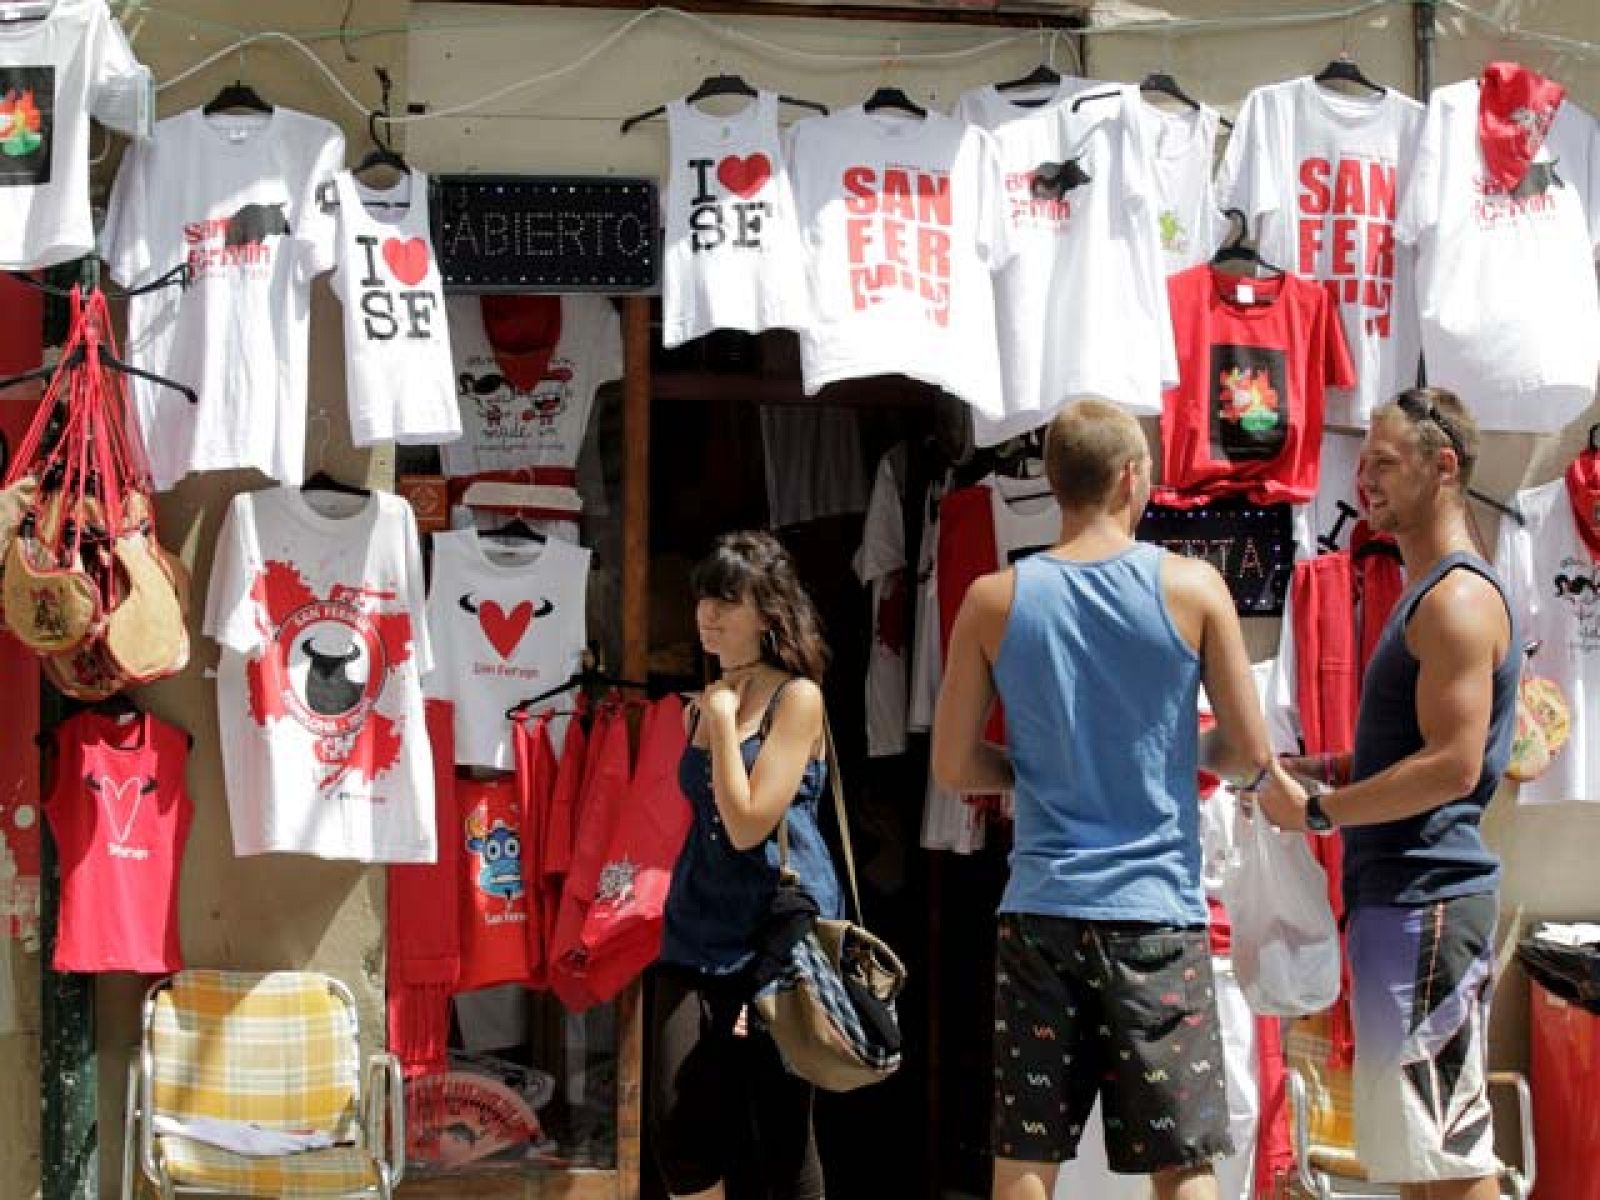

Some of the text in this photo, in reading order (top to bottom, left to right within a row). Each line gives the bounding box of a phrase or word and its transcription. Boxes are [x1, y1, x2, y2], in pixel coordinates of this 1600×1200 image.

[688, 159, 717, 206] I
[842, 166, 953, 226] SAN
[1297, 156, 1397, 222] SAN
[450, 212, 644, 257] ABIERTO
[689, 203, 773, 254] SF
[846, 217, 952, 279] FER
[1298, 218, 1396, 280] FER
[355, 234, 386, 289] I
[360, 288, 438, 341] SF
